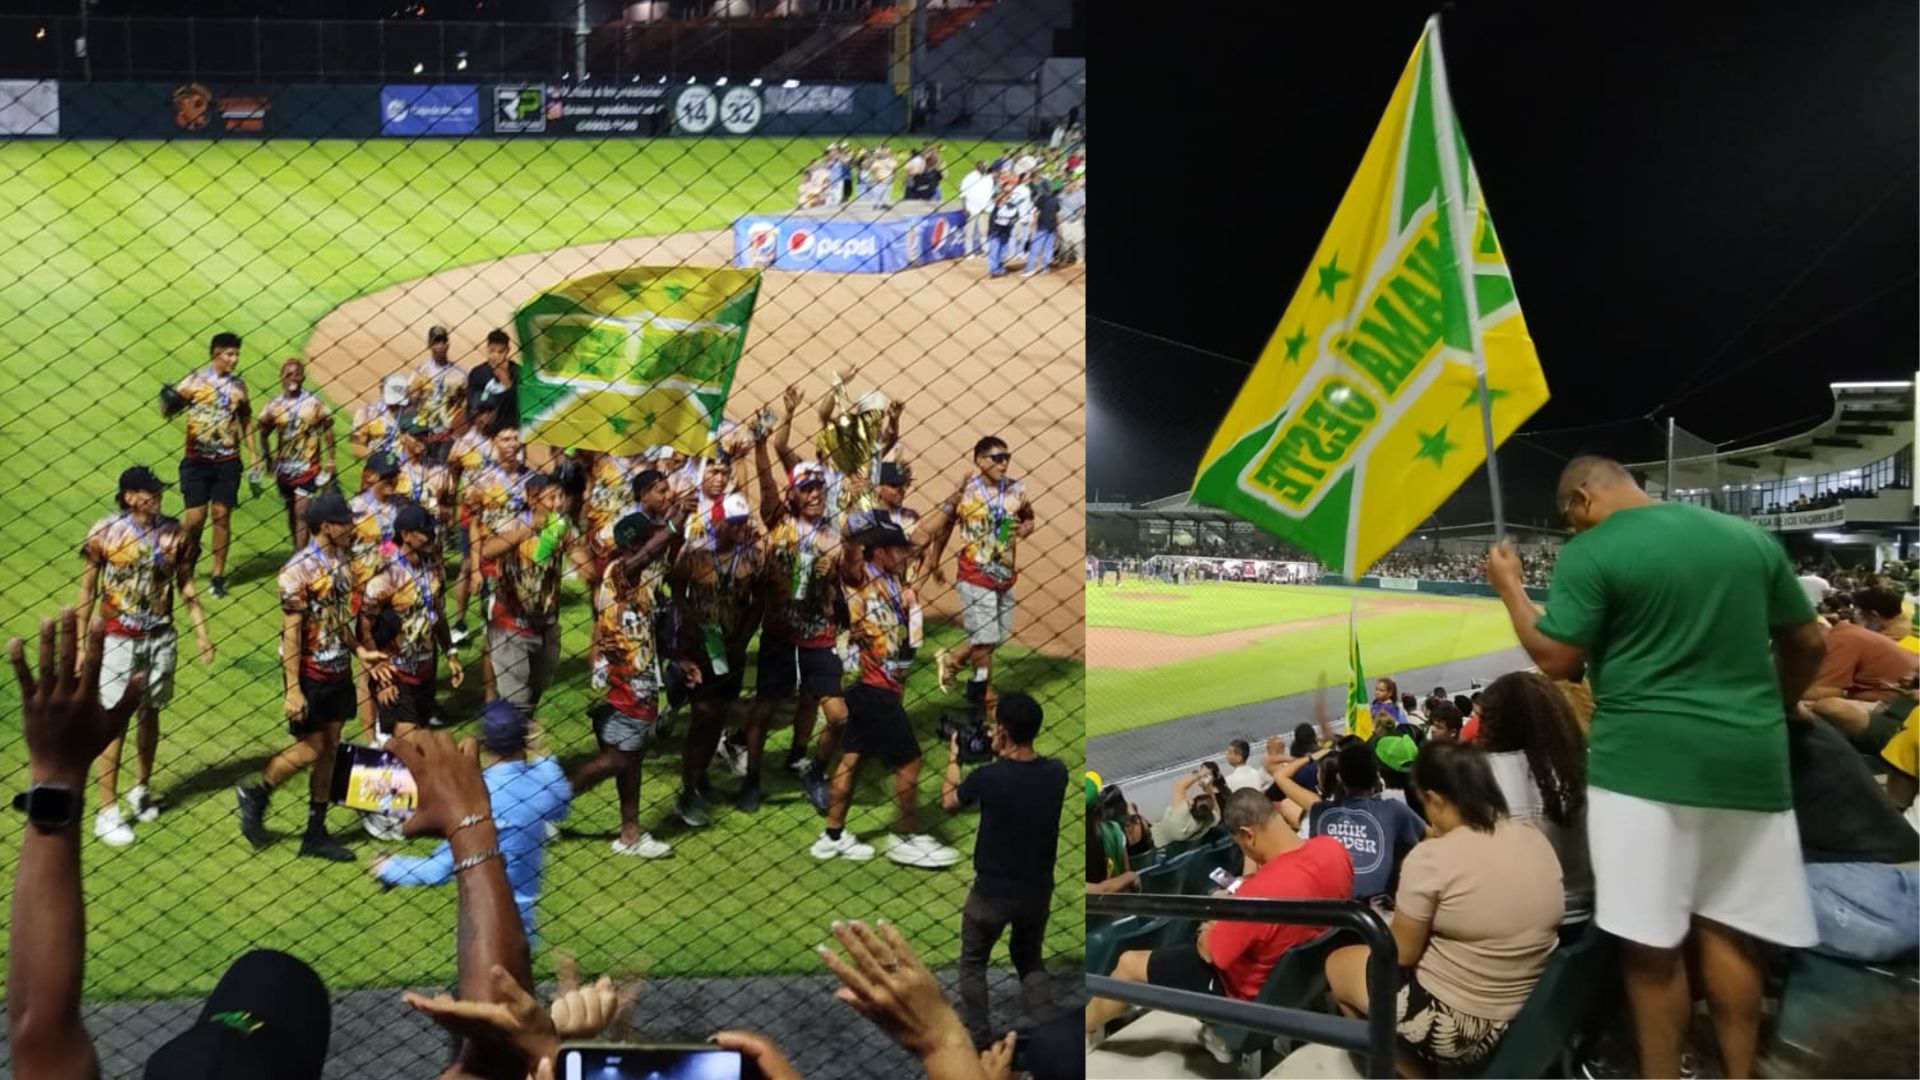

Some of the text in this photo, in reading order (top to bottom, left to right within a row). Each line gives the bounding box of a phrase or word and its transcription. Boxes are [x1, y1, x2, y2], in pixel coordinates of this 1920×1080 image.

[681, 100, 708, 125] 14
[726, 101, 755, 124] 32
[815, 234, 877, 259] pepsi
